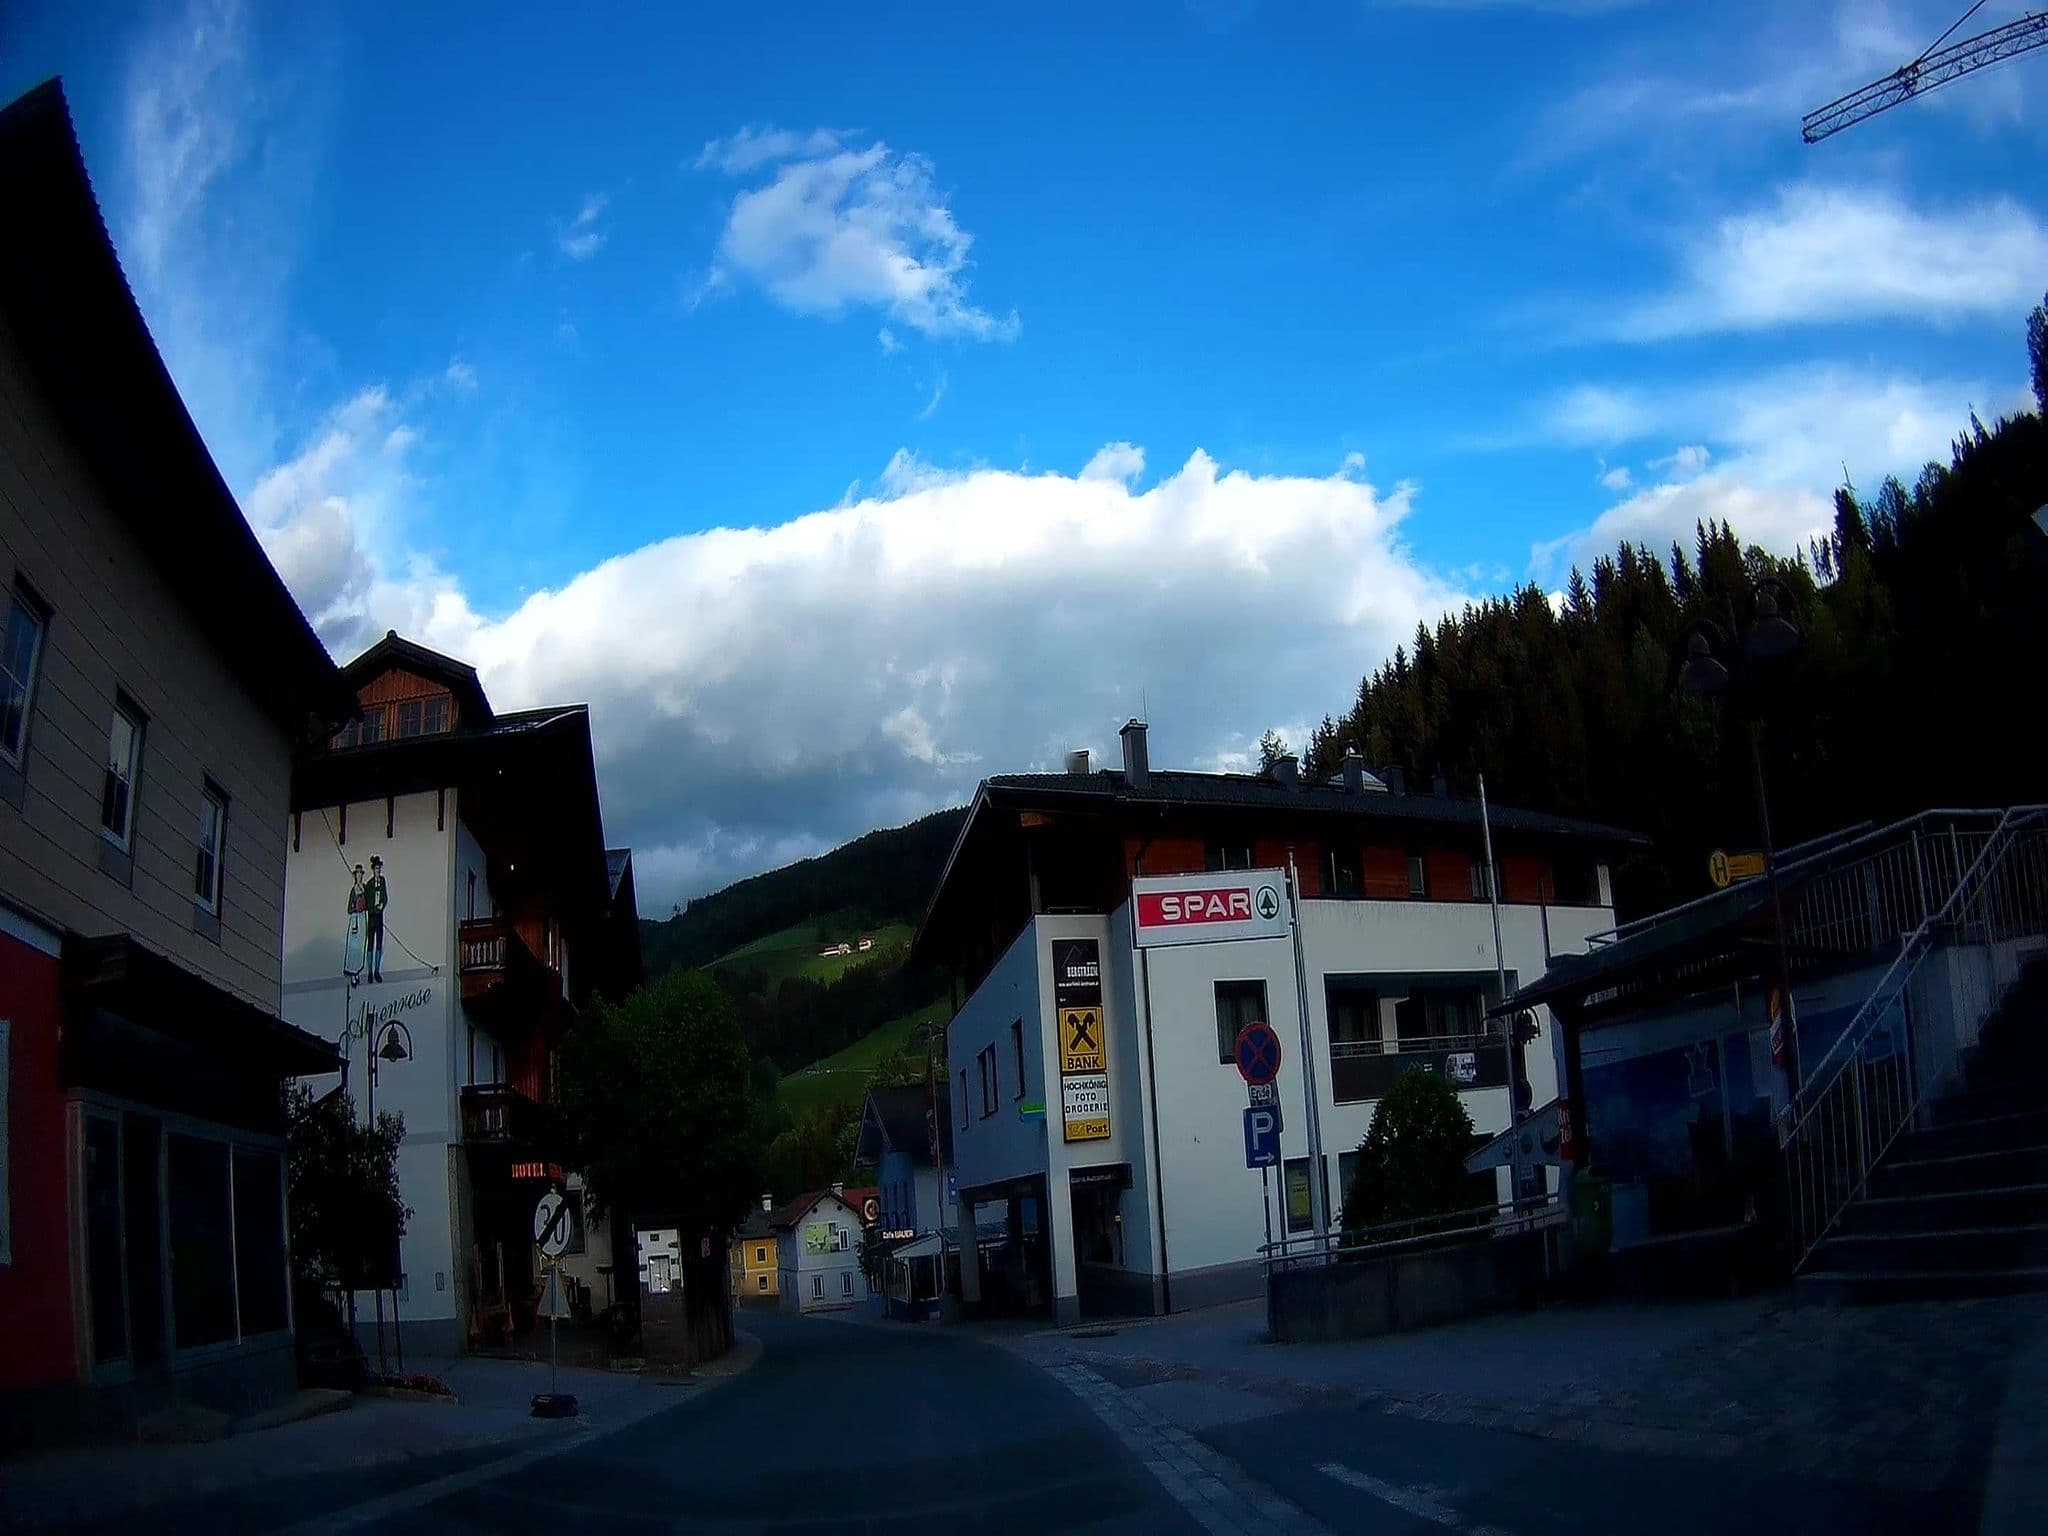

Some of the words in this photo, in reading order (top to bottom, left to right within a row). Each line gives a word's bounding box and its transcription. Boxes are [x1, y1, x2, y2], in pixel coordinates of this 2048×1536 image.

[1161, 892, 1250, 921] SPAR
[1067, 1056, 1101, 1070] BANK
[1064, 1080, 1107, 1091] HOCHKÖNIG
[1075, 1092, 1097, 1102] FOTO
[1065, 1102, 1109, 1114] DROGERIE
[1086, 1124, 1108, 1133] Post
[1252, 1112, 1273, 1150] P
[511, 1162, 546, 1178] HOTEL
